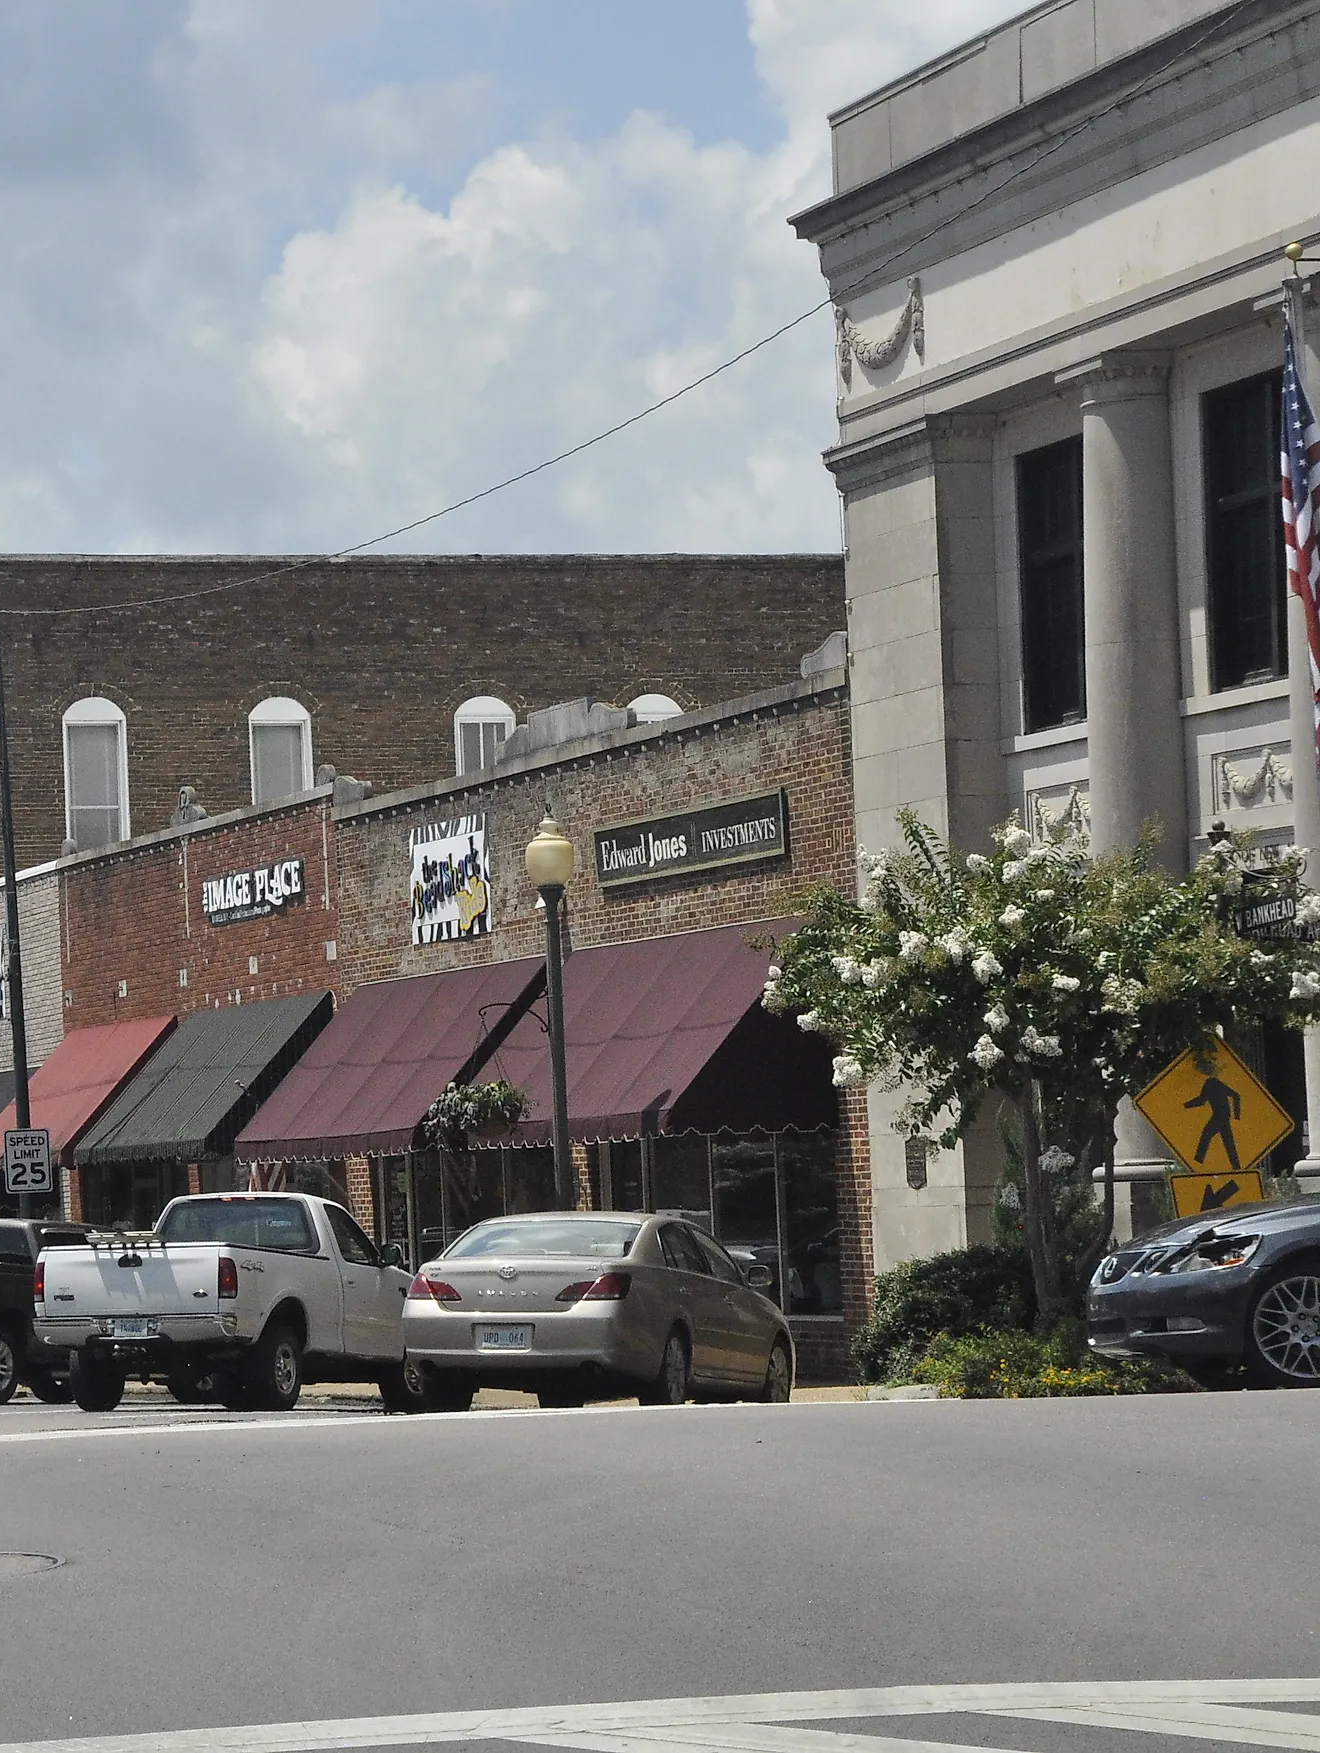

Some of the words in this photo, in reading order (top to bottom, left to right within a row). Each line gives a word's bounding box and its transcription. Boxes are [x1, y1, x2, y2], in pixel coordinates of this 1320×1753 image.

[600, 834, 647, 872] Edward
[648, 832, 688, 868] Jones
[701, 817, 776, 853] INVESTMENTS
[208, 873, 251, 913] IMAGE
[254, 860, 301, 906] PLACE
[1245, 898, 1295, 928] BANKHEAD
[9, 1136, 45, 1147] SPEED
[13, 1149, 41, 1160] LIMIT
[11, 1162, 46, 1186] 25
